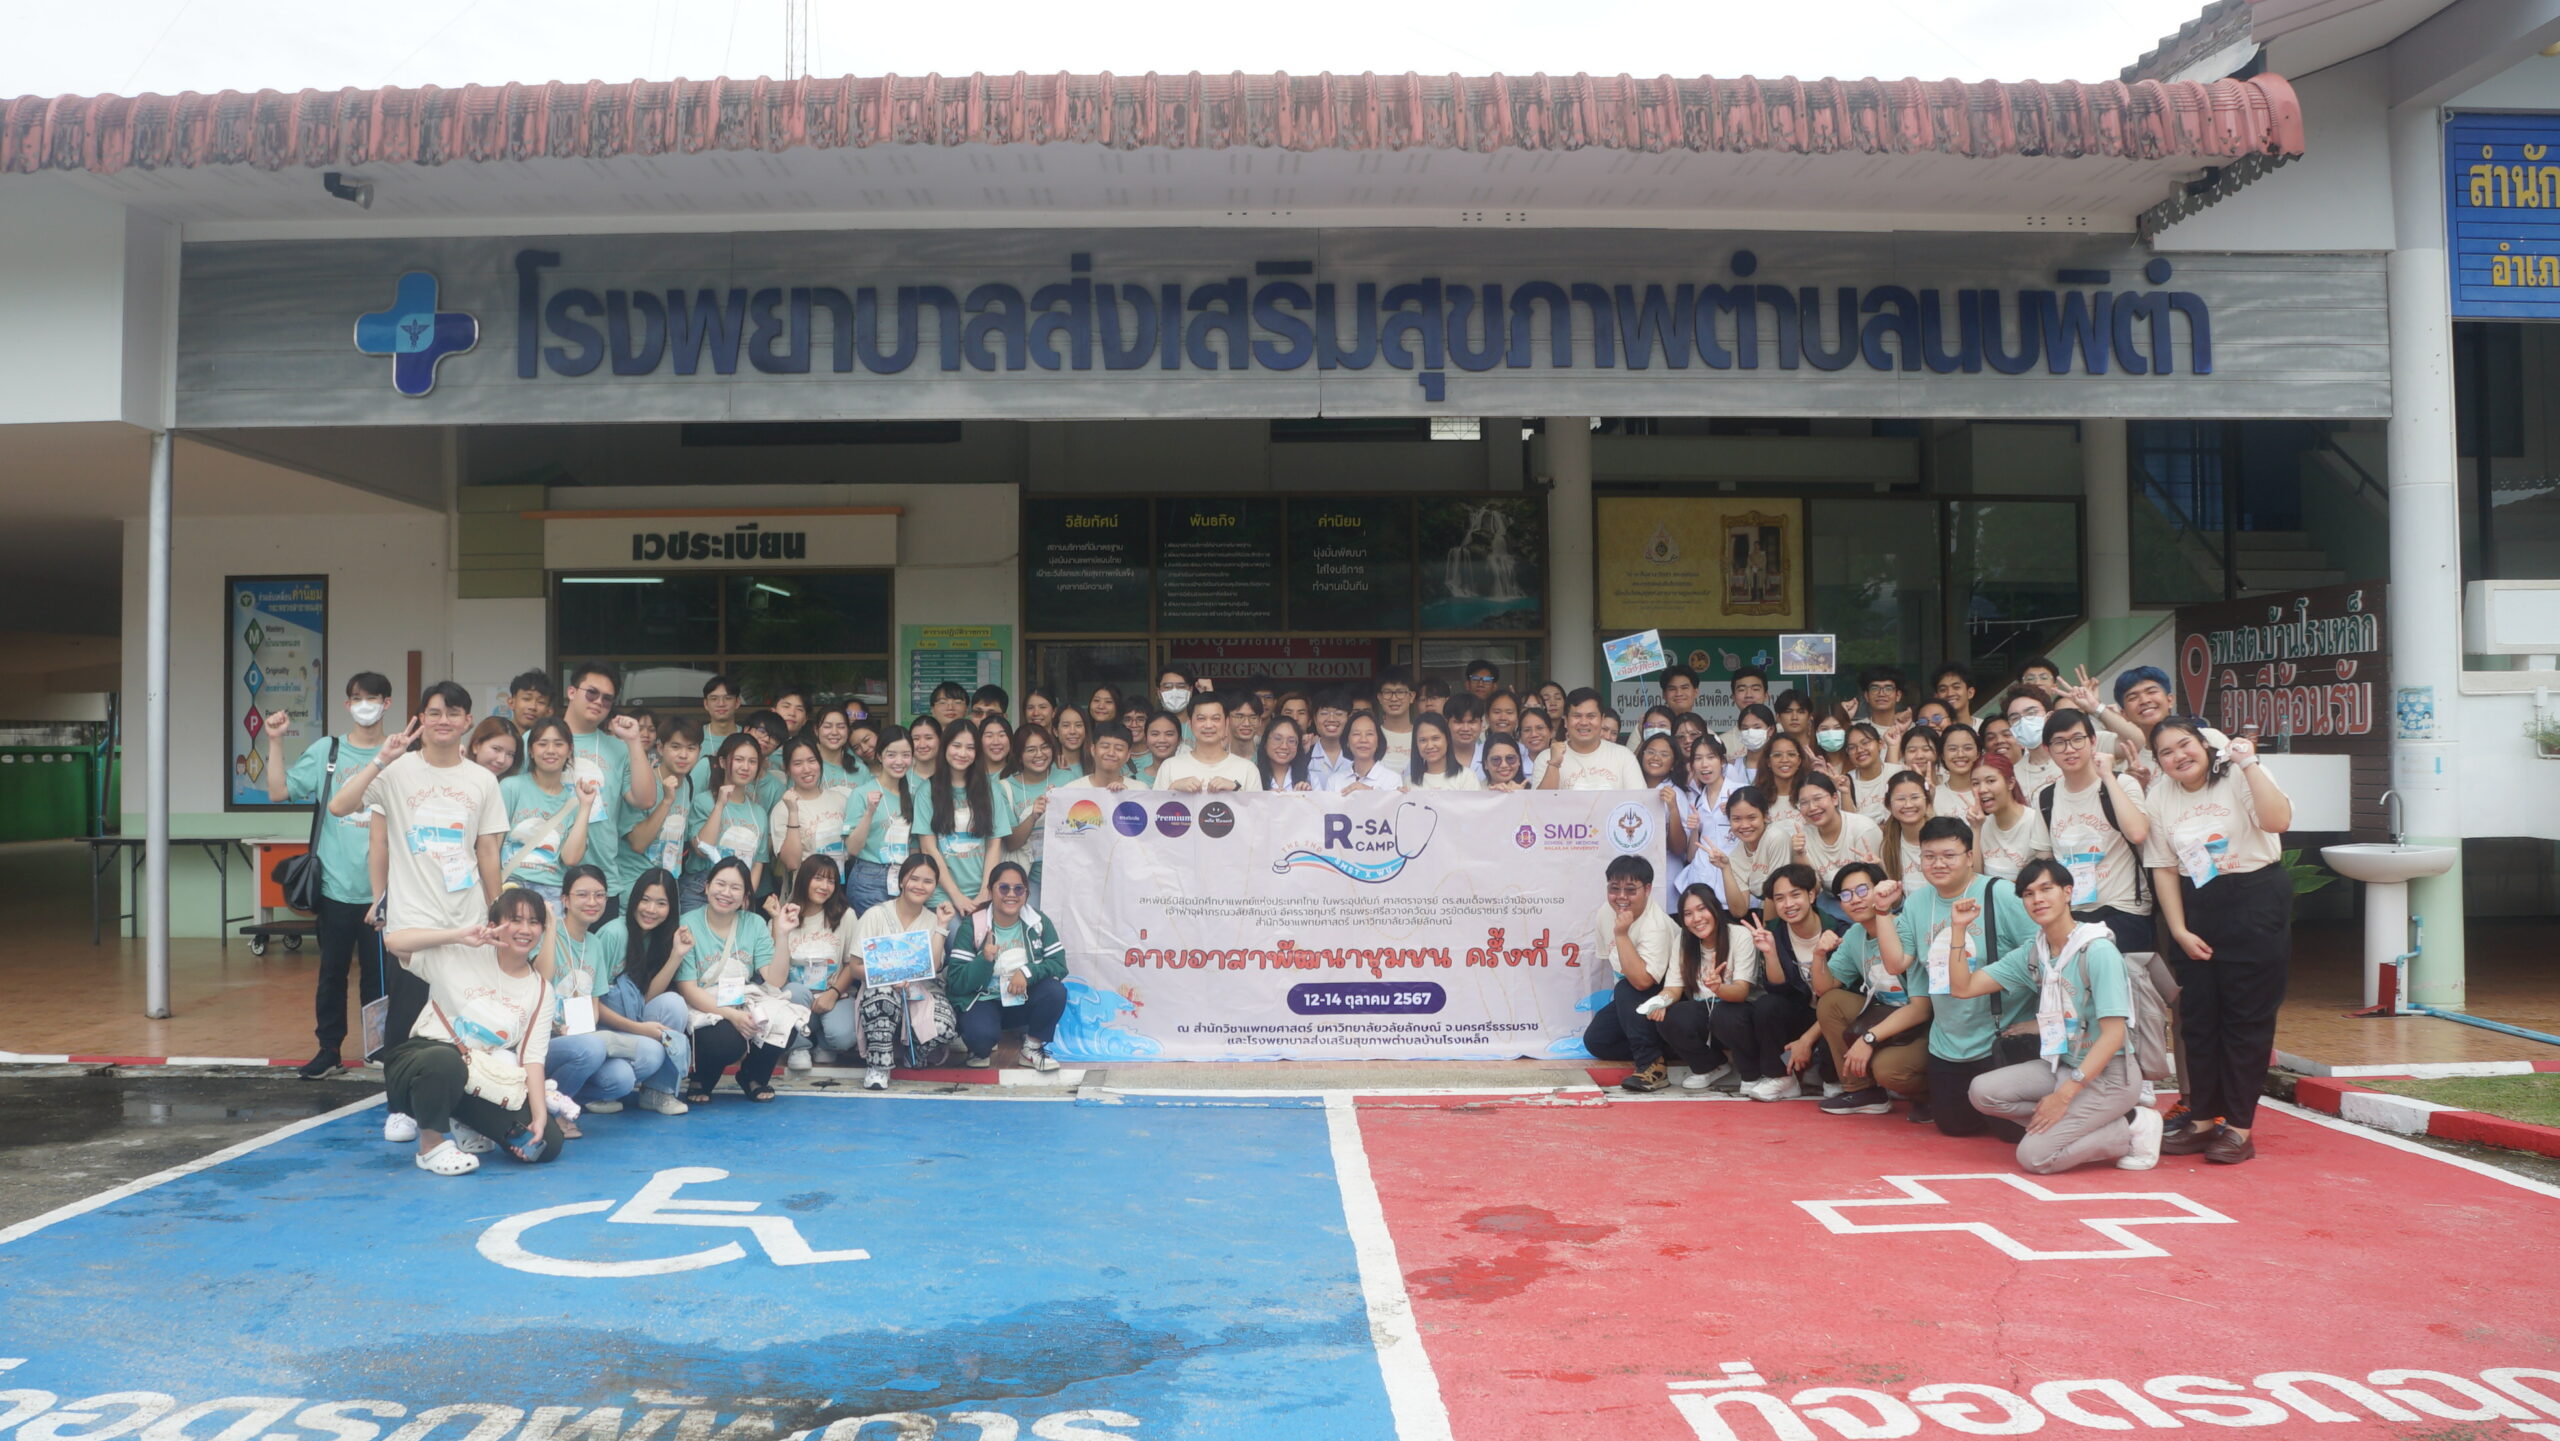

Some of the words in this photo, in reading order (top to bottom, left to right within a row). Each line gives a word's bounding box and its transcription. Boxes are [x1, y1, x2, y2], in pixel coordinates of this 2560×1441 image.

[1065, 513, 1119, 528] วิสัยทัศน์
[1190, 512, 1236, 527] พันธกิจ
[1318, 513, 1361, 528] ค่านิยม
[632, 523, 806, 560] เวชระเบียน
[1316, 563, 1364, 575] ใส่ใจบริการ
[1312, 579, 1369, 591] ทำงานเป็นทีม
[2209, 590, 2378, 665] รพ.สต.บ้านโรงเหล็ก
[249, 629, 260, 644] M
[1186, 662, 1296, 677] MERGENCY
[1308, 662, 1364, 676] ROOM
[249, 670, 259, 685] O
[2220, 658, 2373, 737] ยินดีต้อนรับ
[250, 716, 258, 730] P
[249, 758, 259, 773] H
[1155, 814, 1192, 822] Premium
[1355, 841, 1395, 853] CAMP
[1376, 866, 1393, 877] WU
[1512, 905, 1543, 915] ร่วมกับ
[1125, 929, 1452, 978] ค่ายอาสาพัฒนาชุมชน
[1466, 928, 1550, 968] ครั้งที่
[1561, 943, 1581, 968] 2
[1304, 993, 1342, 1007] 12-14
[1345, 993, 1390, 1009] ตุลาคม
[1394, 992, 1432, 1006] 2567
[1177, 1024, 1189, 1033] ณ
[1193, 1022, 1313, 1034] สำนักวิชาแพทยศาสตร์
[1317, 1021, 1441, 1034] มหาวิทยาลัยวลัยลักษณ์
[1445, 1021, 1539, 1033] จ.นครศรีธรรมราช
[1227, 1033, 1489, 1047] และโรงพยาบาลส่งเสริมสุขภาพตำบลบ้านโรงเหล็ก
